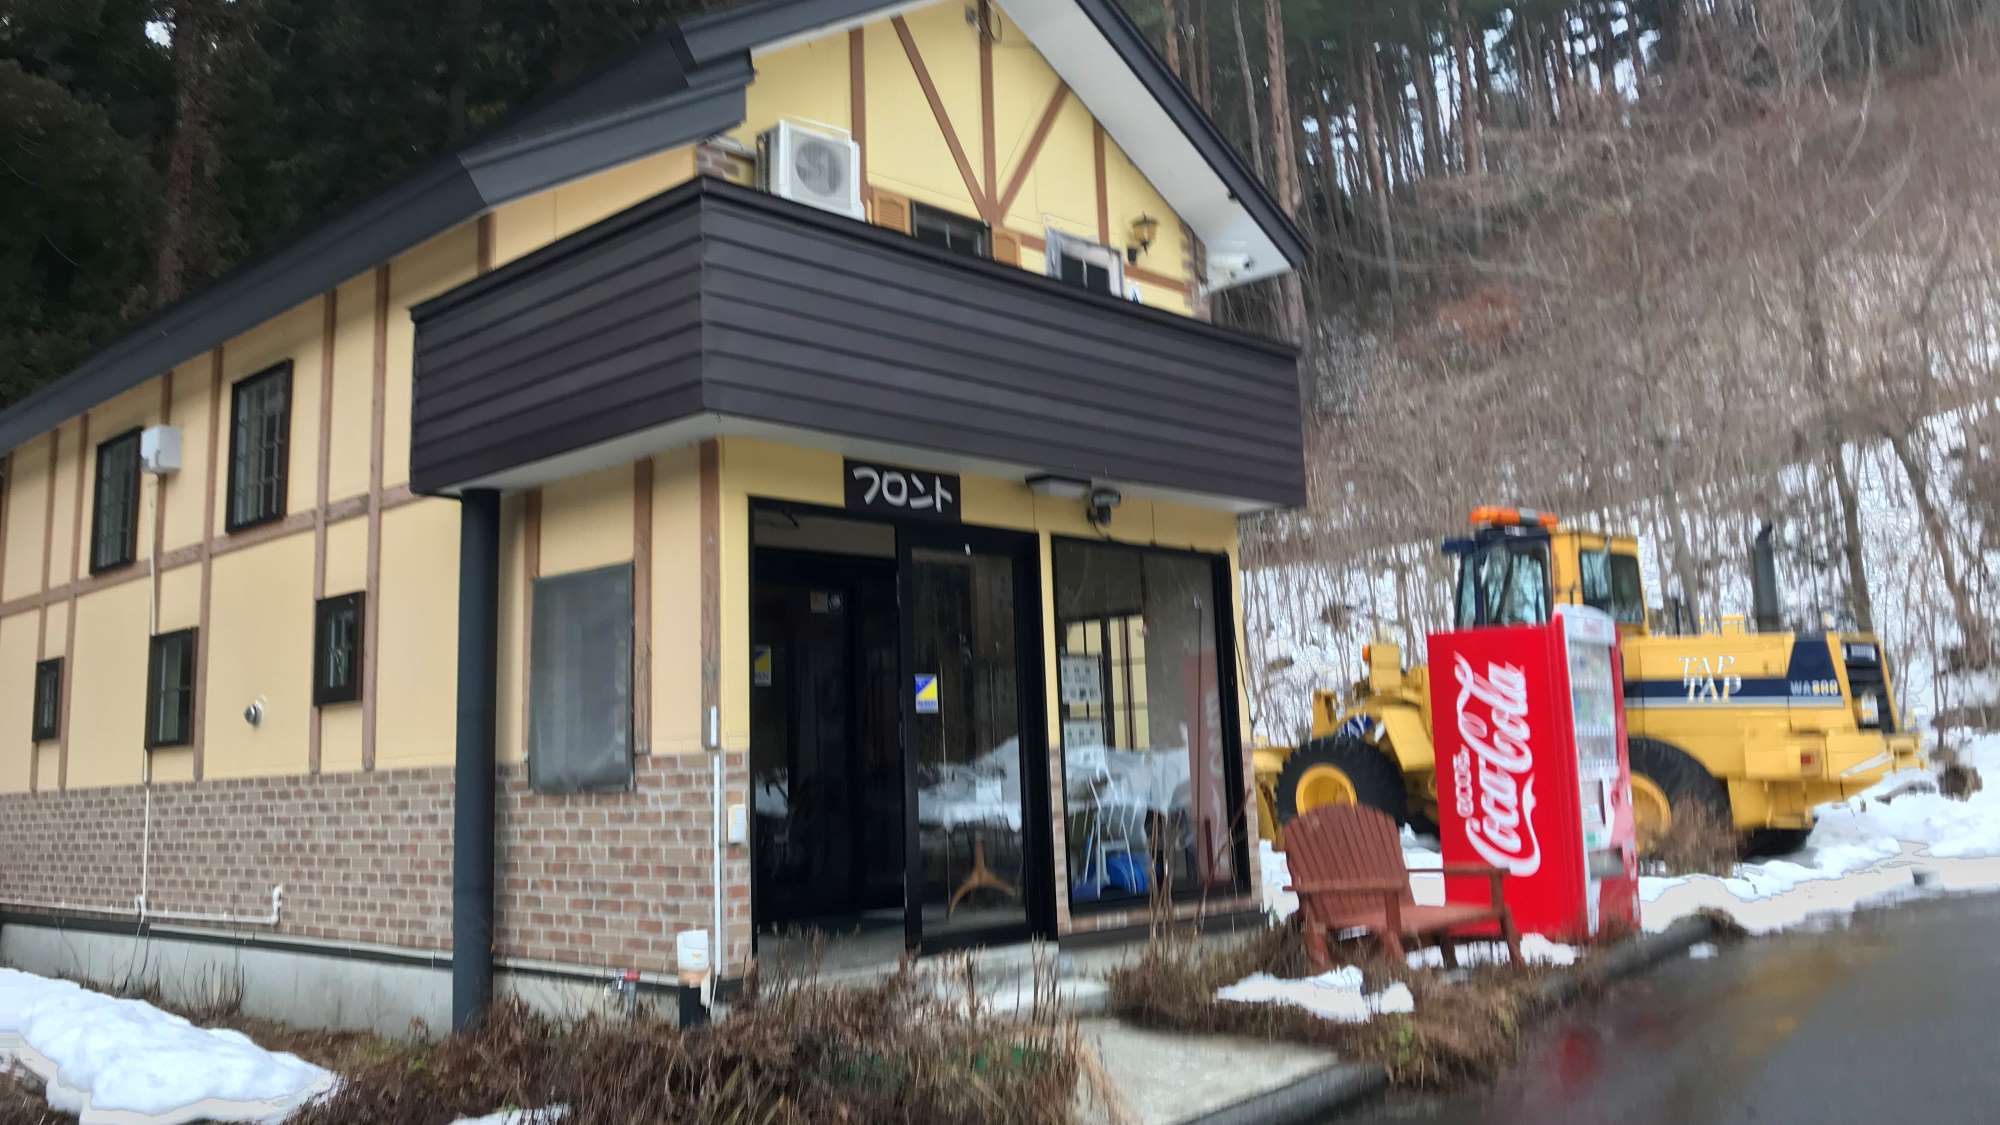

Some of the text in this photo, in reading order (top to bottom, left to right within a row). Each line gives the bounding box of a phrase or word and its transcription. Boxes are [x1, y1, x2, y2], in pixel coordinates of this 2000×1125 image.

[852, 466, 953, 512] フロント
[1454, 651, 1541, 877] Coca-Cola
